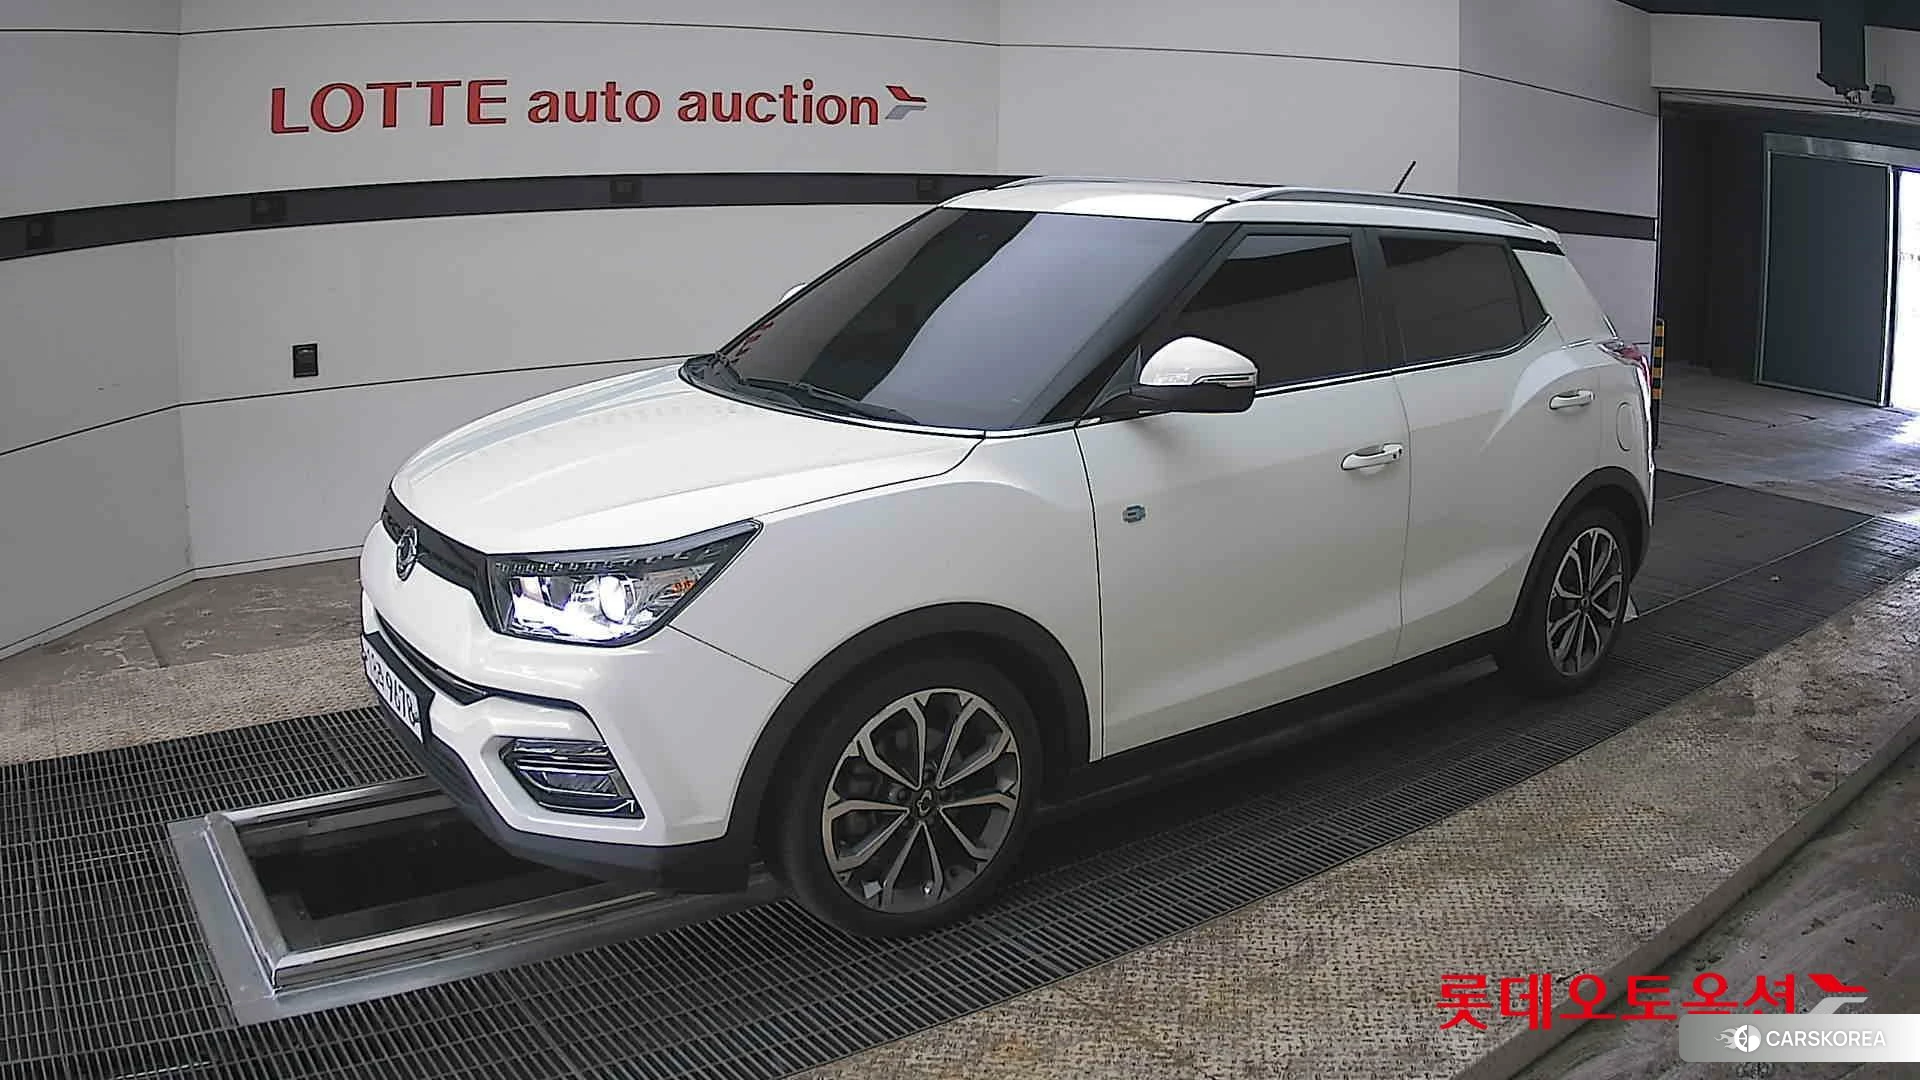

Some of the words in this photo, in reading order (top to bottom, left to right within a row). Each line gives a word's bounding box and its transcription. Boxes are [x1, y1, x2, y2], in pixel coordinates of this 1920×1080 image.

[271, 79, 507, 135] LOTTE
[528, 81, 662, 124] auto
[677, 78, 879, 125] auction
